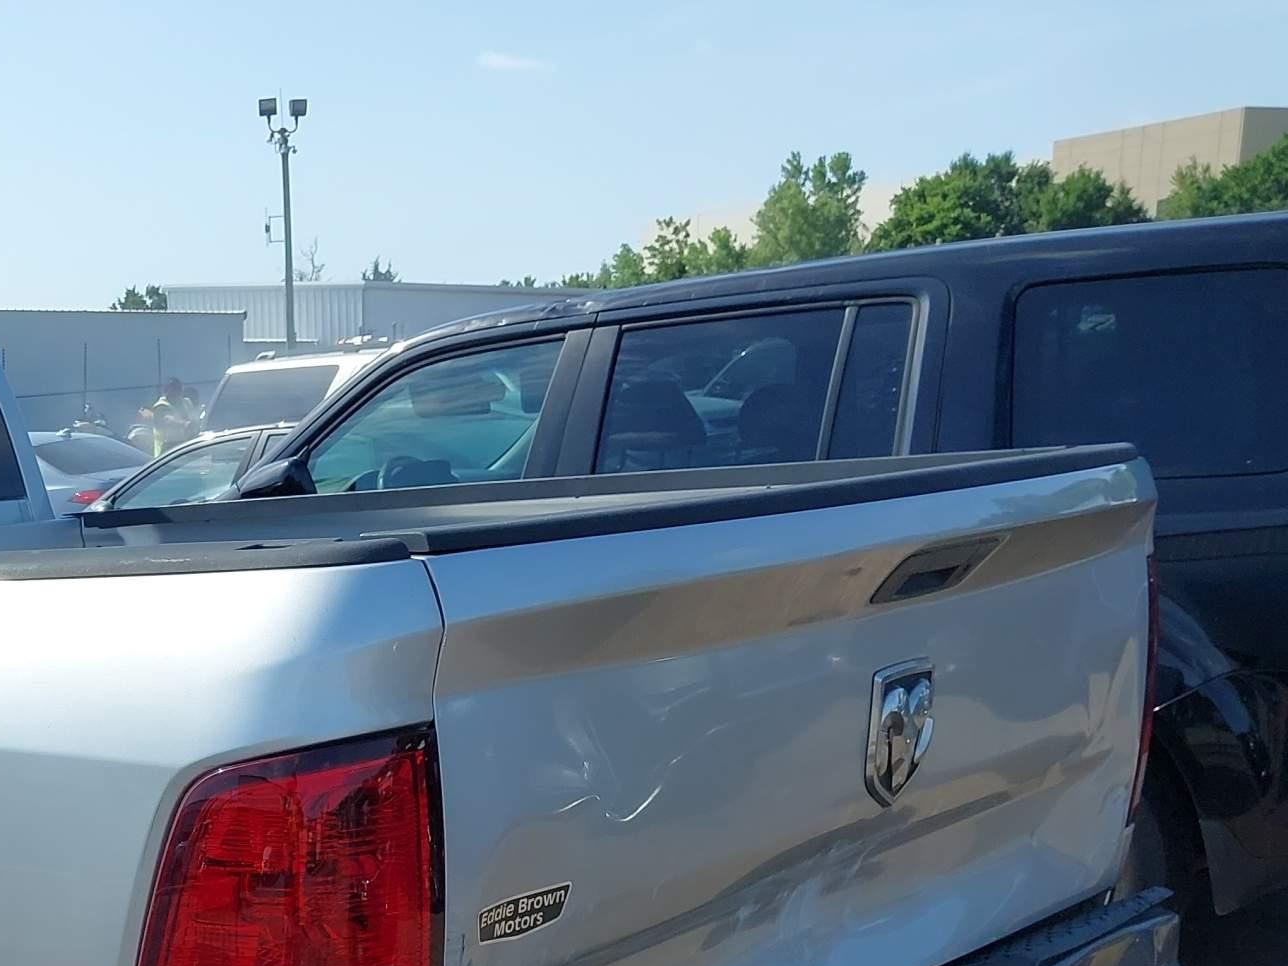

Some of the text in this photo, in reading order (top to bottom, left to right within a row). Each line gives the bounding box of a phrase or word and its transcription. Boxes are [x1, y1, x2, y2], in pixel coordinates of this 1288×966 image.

[481, 889, 565, 928] Eddie Brown
[493, 911, 544, 937] Motors
